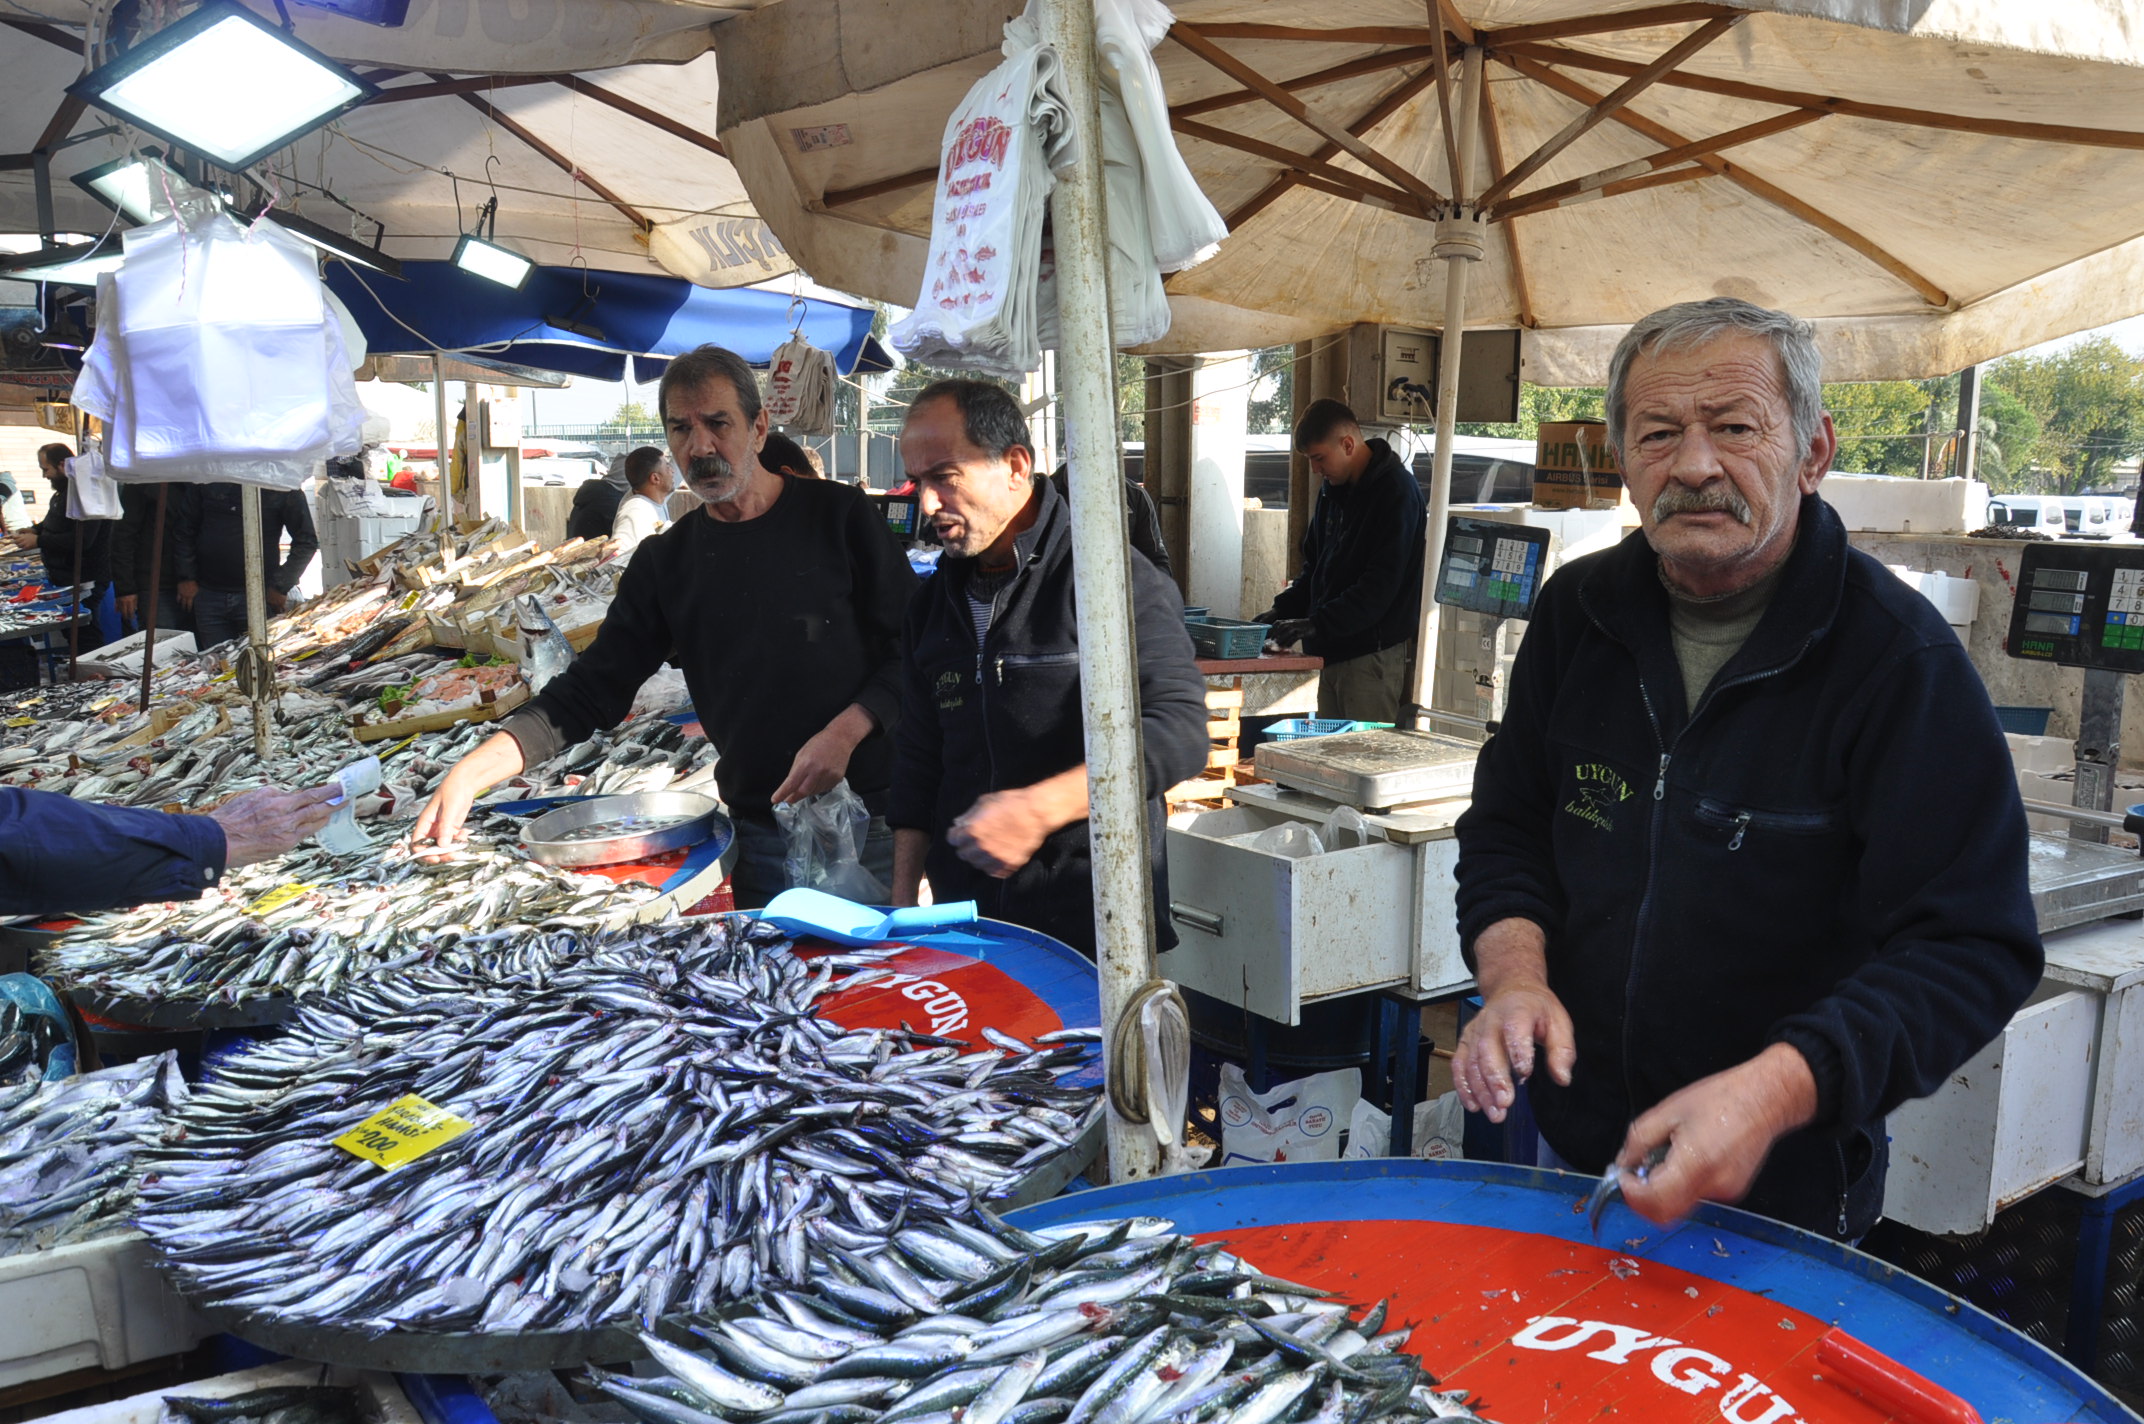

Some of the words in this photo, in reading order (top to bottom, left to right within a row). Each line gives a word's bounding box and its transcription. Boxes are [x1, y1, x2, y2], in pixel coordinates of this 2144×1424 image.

[1542, 442, 1616, 469] HANA
[1546, 472, 1582, 482] AIRBUS
[2022, 640, 2054, 652] HANA
[1575, 763, 1634, 801] UYGUN
[871, 973, 968, 1037] YGUN
[356, 1130, 399, 1151] 200
[1512, 1315, 1808, 1424] UYGU
